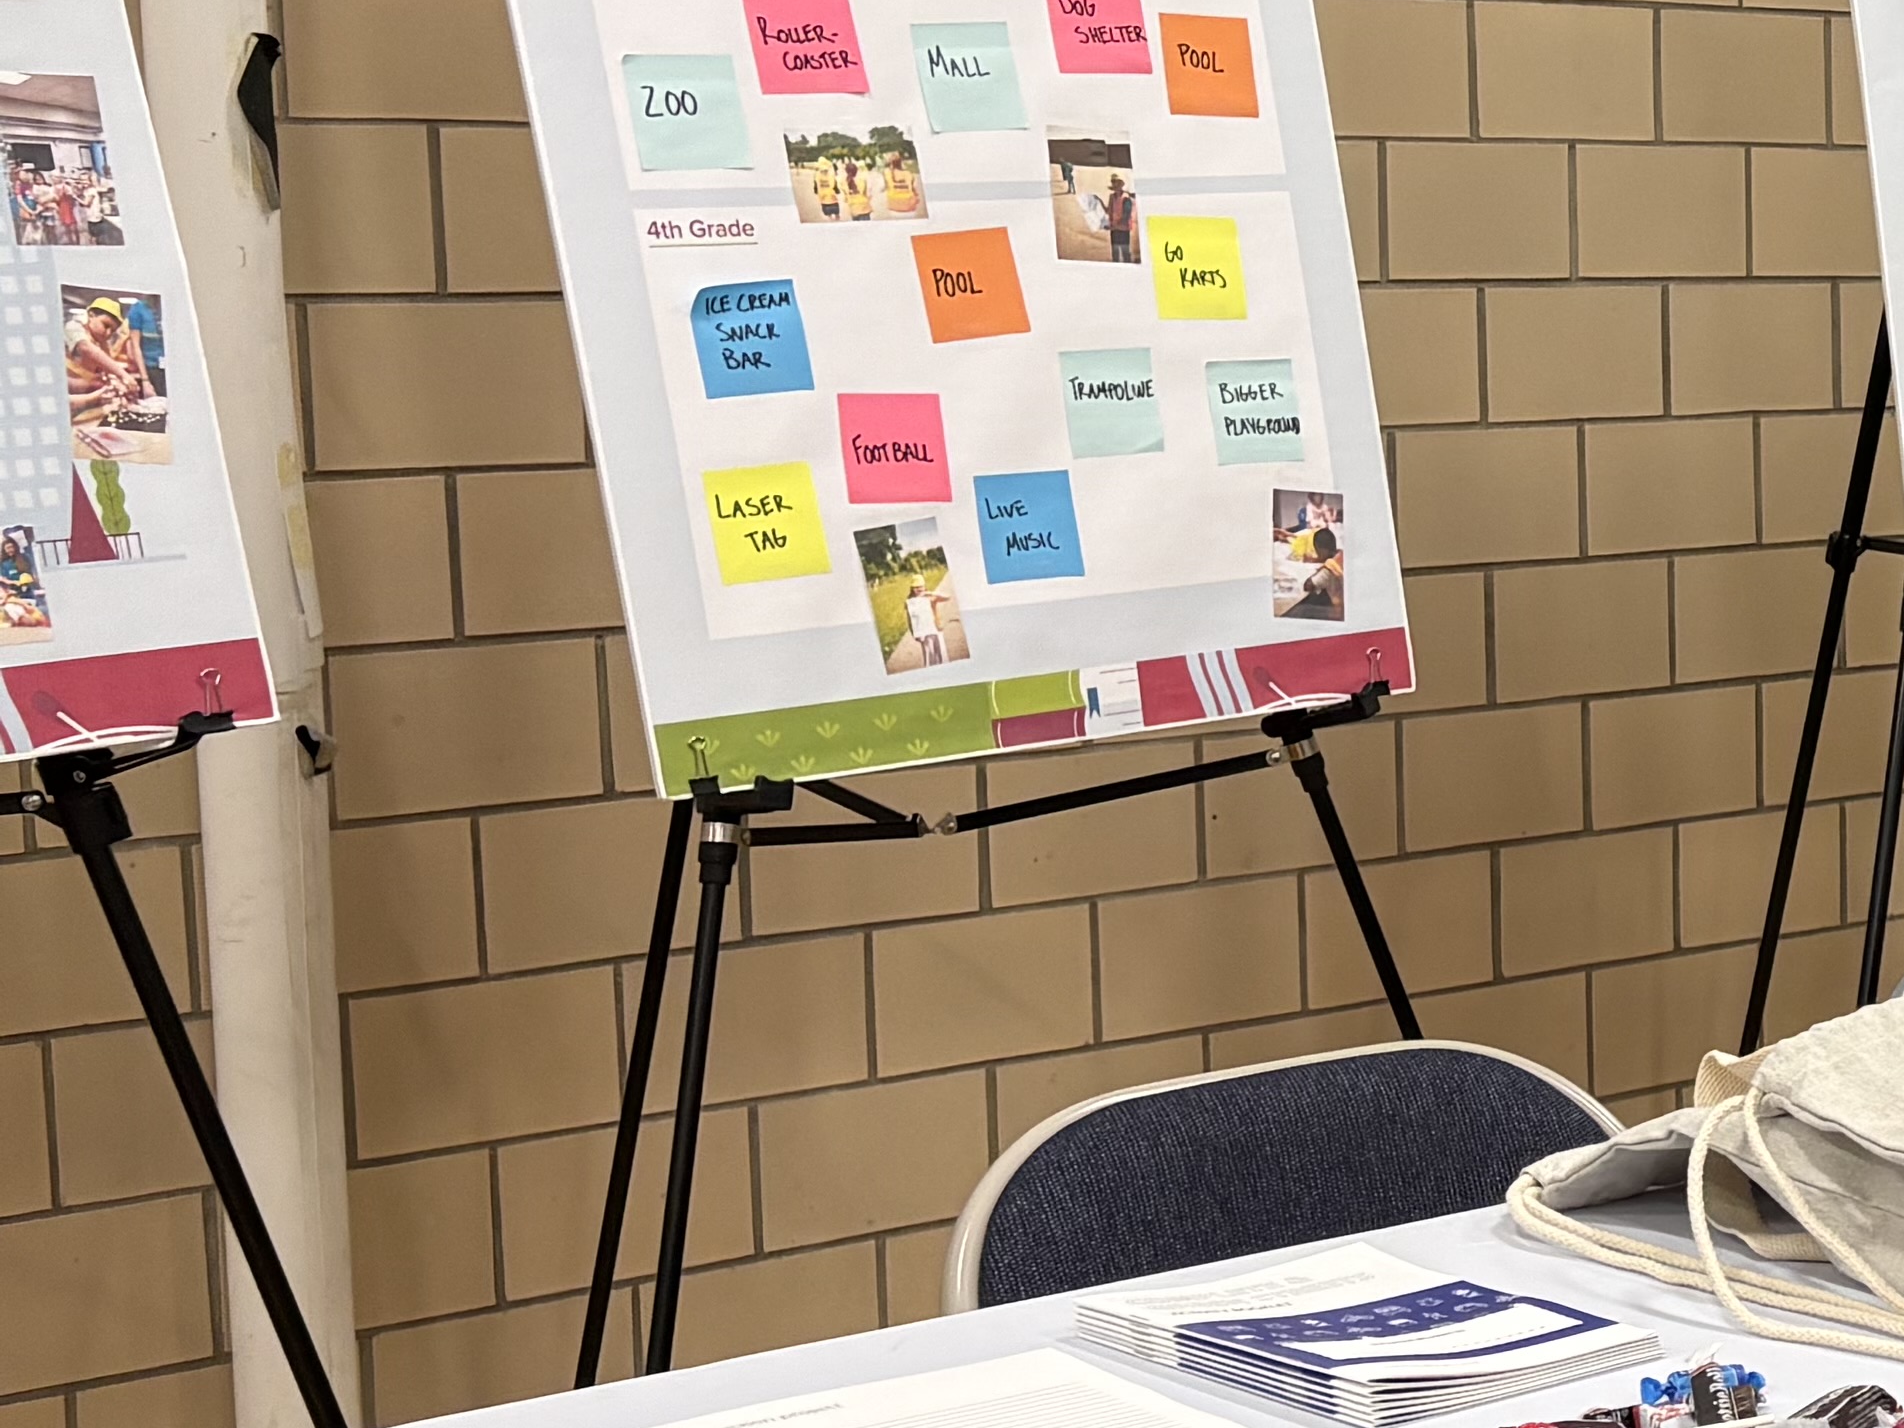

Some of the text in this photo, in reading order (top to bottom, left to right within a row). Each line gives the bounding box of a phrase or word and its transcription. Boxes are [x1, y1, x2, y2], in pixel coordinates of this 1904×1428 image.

[757, 15, 839, 46] ROLLER-
[1075, 25, 1148, 44] SHELTER
[783, 49, 858, 72] COASTER
[928, 45, 991, 79] MALL
[1177, 43, 1226, 75] POOL
[642, 85, 699, 118] ZOO
[647, 217, 756, 242] 4th Grade
[1163, 242, 1185, 263] GO
[931, 267, 984, 298] POOL
[1180, 267, 1228, 290] KARTS
[704, 289, 791, 317] ICE CREAM
[717, 320, 781, 343] SNACK
[722, 349, 773, 371] BAR
[1068, 376, 1155, 404] TRAMPOLINE
[1219, 382, 1284, 405] BIGGER
[1224, 412, 1301, 438] PLAYGROUND
[714, 494, 793, 519] LASER
[985, 498, 1029, 520] LIVE
[744, 527, 789, 552] TAG
[1005, 530, 1061, 556] MUSIC
